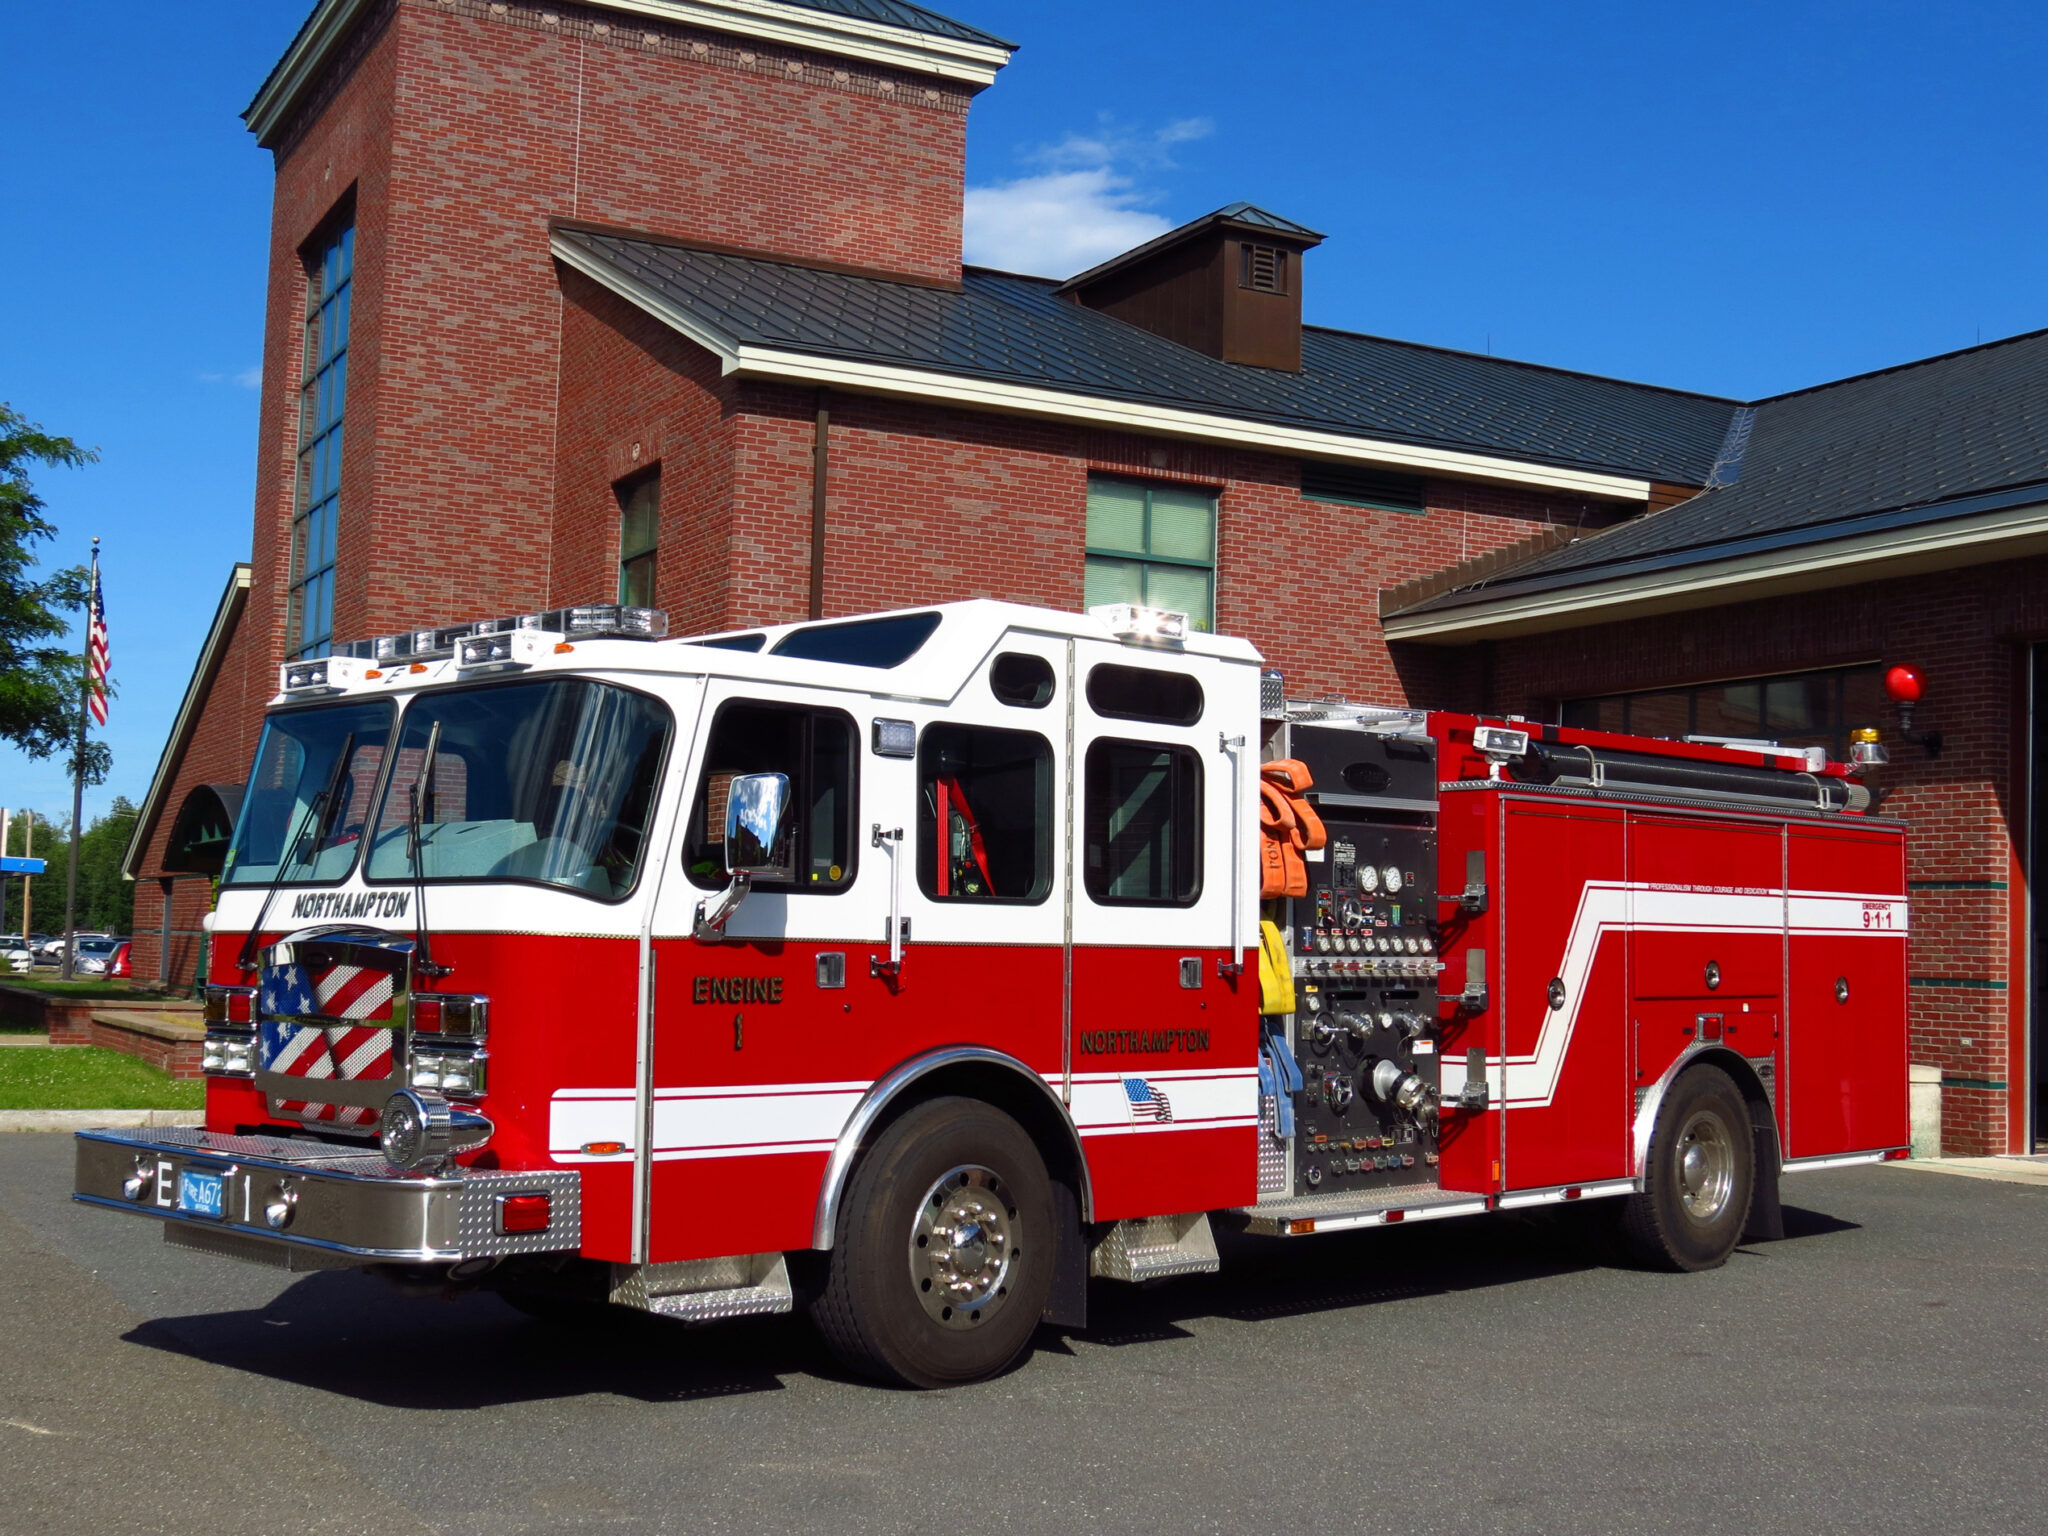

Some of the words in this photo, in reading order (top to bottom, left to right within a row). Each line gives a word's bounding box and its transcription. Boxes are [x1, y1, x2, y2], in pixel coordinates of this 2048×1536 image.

[384, 667, 406, 685] E
[291, 891, 411, 919] NORTHAMPTON
[1862, 902, 1891, 910] EMERGENCY
[693, 976, 783, 1004] ENGINE
[734, 1013, 743, 1051] 1
[1080, 1029, 1210, 1054] NORTHAMPTON
[156, 1161, 173, 1207] E
[243, 1175, 251, 1222] 1
